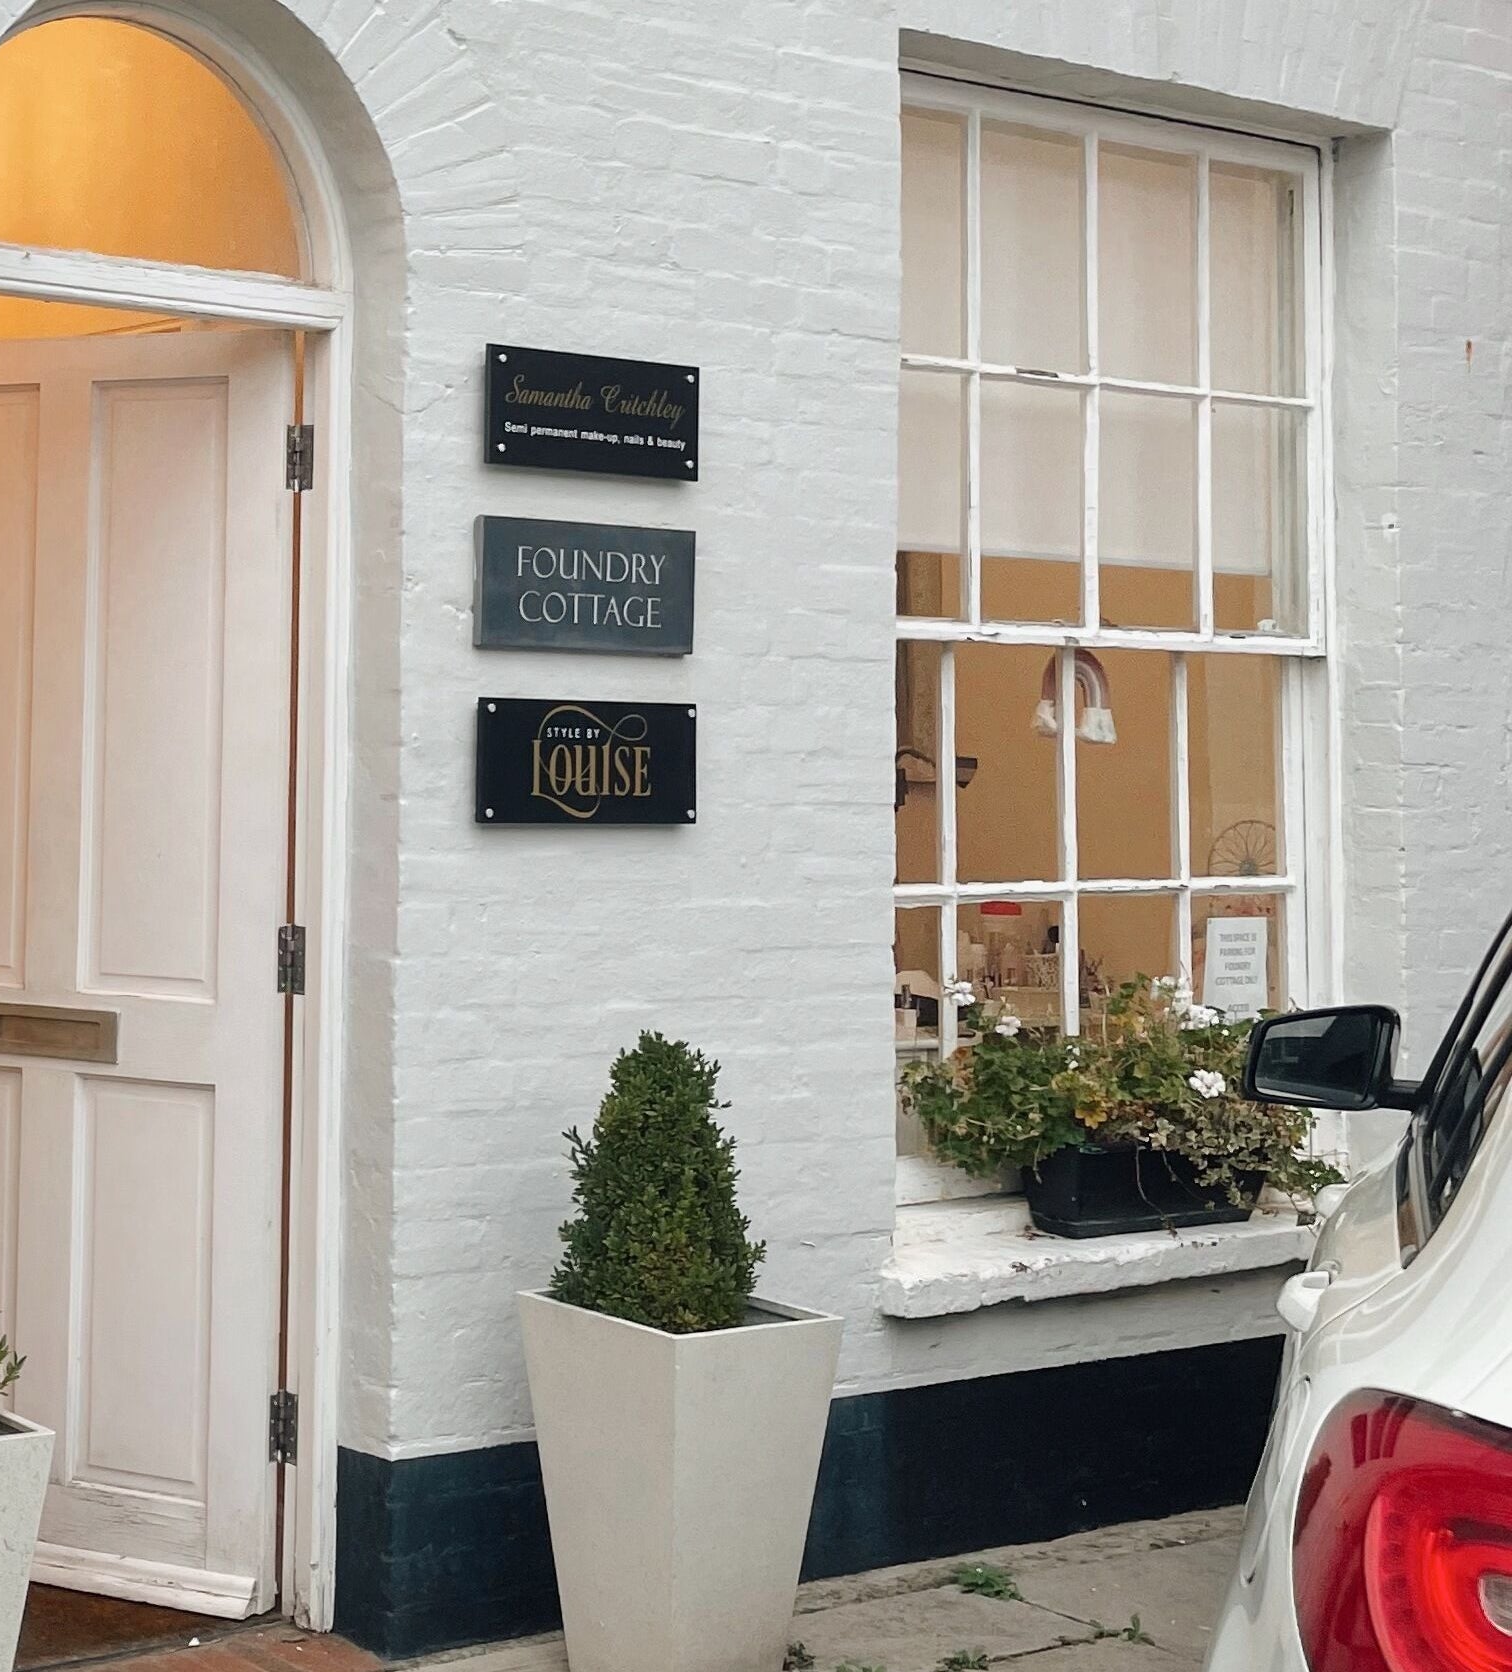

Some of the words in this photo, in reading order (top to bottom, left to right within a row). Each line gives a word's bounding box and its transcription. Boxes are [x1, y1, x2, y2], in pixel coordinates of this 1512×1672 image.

[505, 373, 593, 411] Samantha
[600, 384, 686, 430] Critchley
[504, 421, 528, 434] Semi
[530, 425, 578, 439] permanent
[580, 431, 620, 444] make-up,
[623, 434, 644, 446] nails
[647, 436, 654, 446] &
[656, 437, 686, 451] beauty
[517, 545, 666, 585] FOUNDRY
[518, 590, 662, 628] COTTAGE
[546, 727, 581, 739] STYLE
[586, 728, 601, 739] BY
